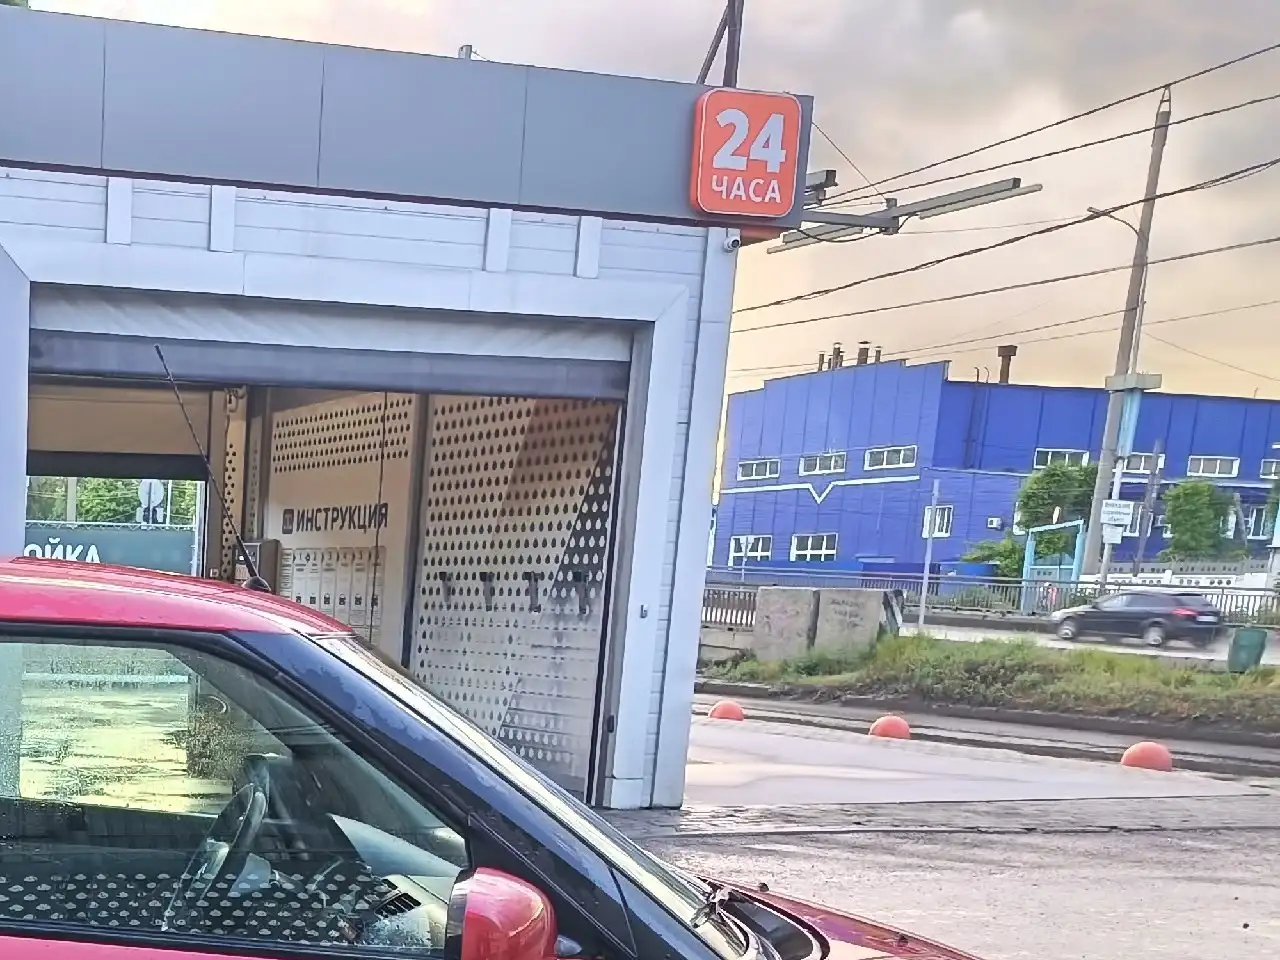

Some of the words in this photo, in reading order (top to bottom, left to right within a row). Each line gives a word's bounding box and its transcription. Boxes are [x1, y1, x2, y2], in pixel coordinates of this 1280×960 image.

[712, 108, 786, 173] 24
[711, 175, 782, 204] ЧАСА
[296, 502, 388, 534] ИНСТРУКЦИЯ
